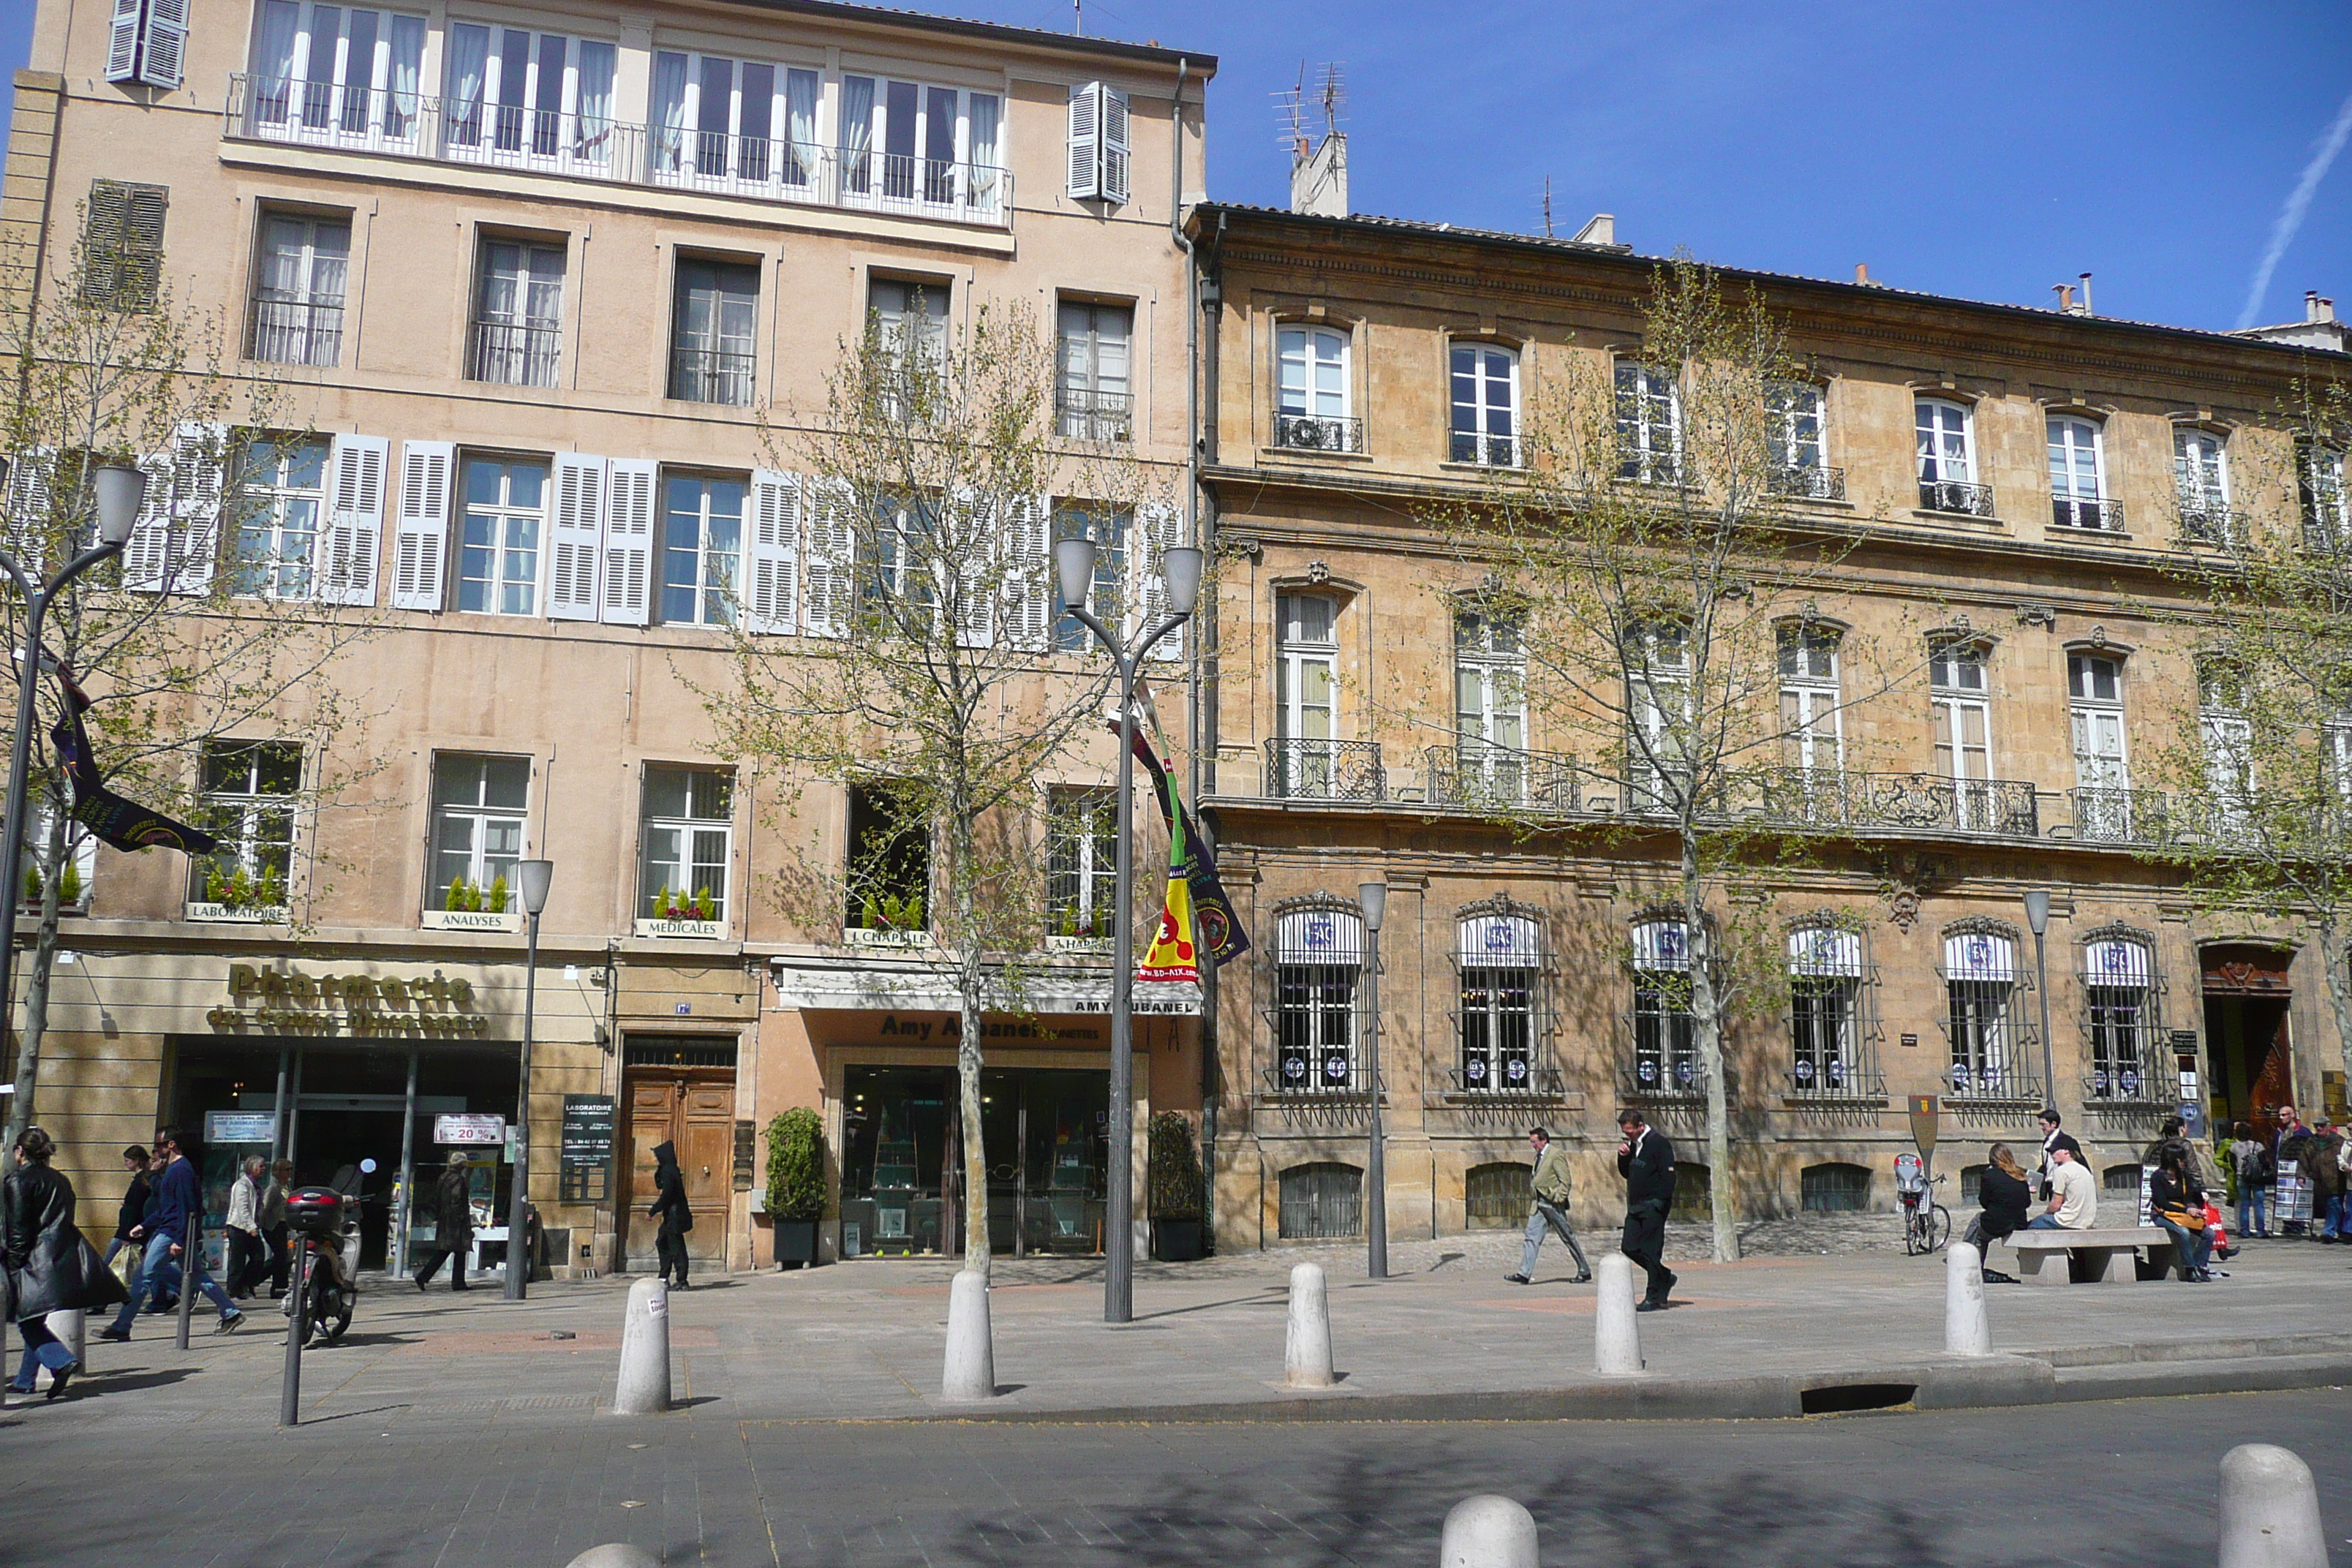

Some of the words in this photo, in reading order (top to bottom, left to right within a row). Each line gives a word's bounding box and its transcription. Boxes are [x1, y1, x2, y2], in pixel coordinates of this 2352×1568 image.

[193, 906, 284, 919] LABORATOIRE
[442, 914, 502, 927] ANALYSES
[649, 922, 716, 935] MEDICALES
[227, 963, 471, 1002] Pharmacie
[1074, 1001, 1111, 1011] AMY
[1131, 1002, 1193, 1013] UBANEL
[206, 1004, 243, 1026] du
[881, 1015, 933, 1041] Amy
[458, 1129, 474, 1139] 20
[478, 1129, 489, 1139] %
